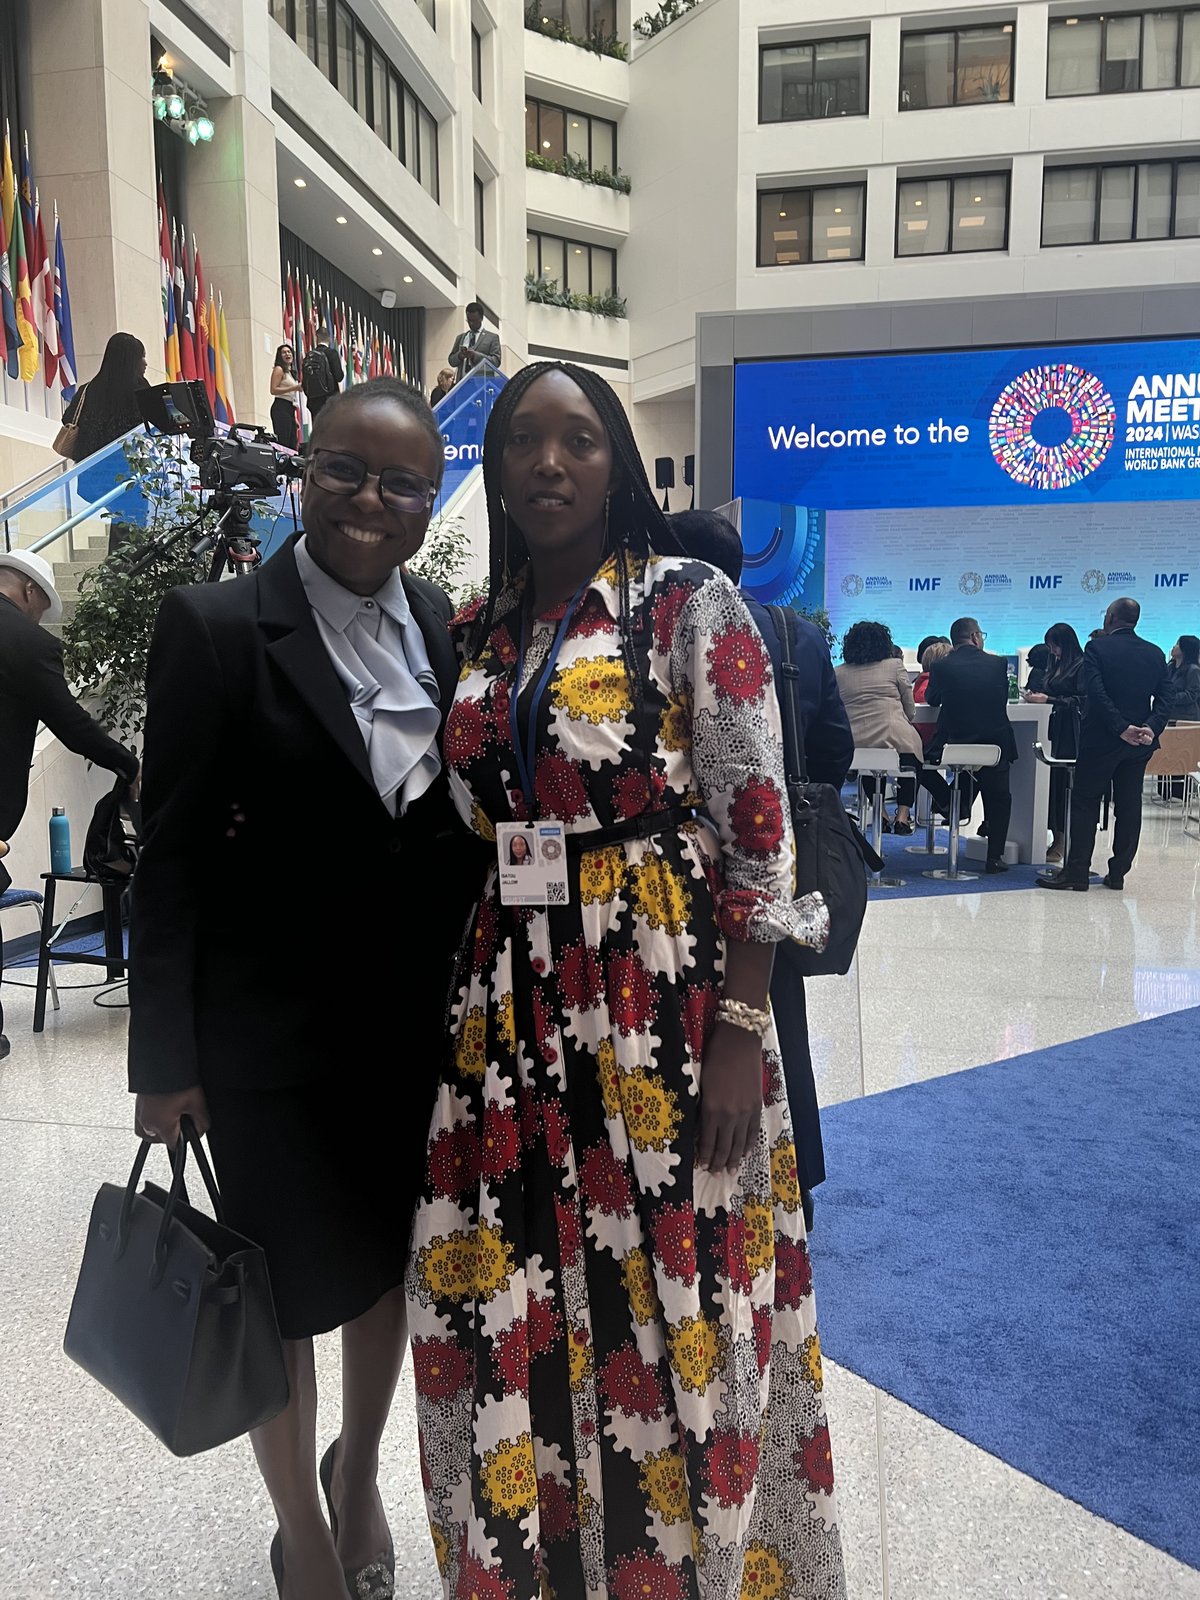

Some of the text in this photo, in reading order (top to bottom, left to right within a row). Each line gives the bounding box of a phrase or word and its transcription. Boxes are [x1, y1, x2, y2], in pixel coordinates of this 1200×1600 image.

[1128, 373, 1200, 400] ANN
[768, 417, 970, 450] Welcome to the
[1125, 424, 1200, 443] 2024 WAS
[1125, 446, 1196, 459] INTERNATIONAL
[1124, 459, 1159, 471] WORLD
[1160, 458, 1187, 470] BANK
[909, 577, 942, 592] IMF
[1029, 575, 1063, 590] IMF
[1154, 573, 1190, 588] IMF
